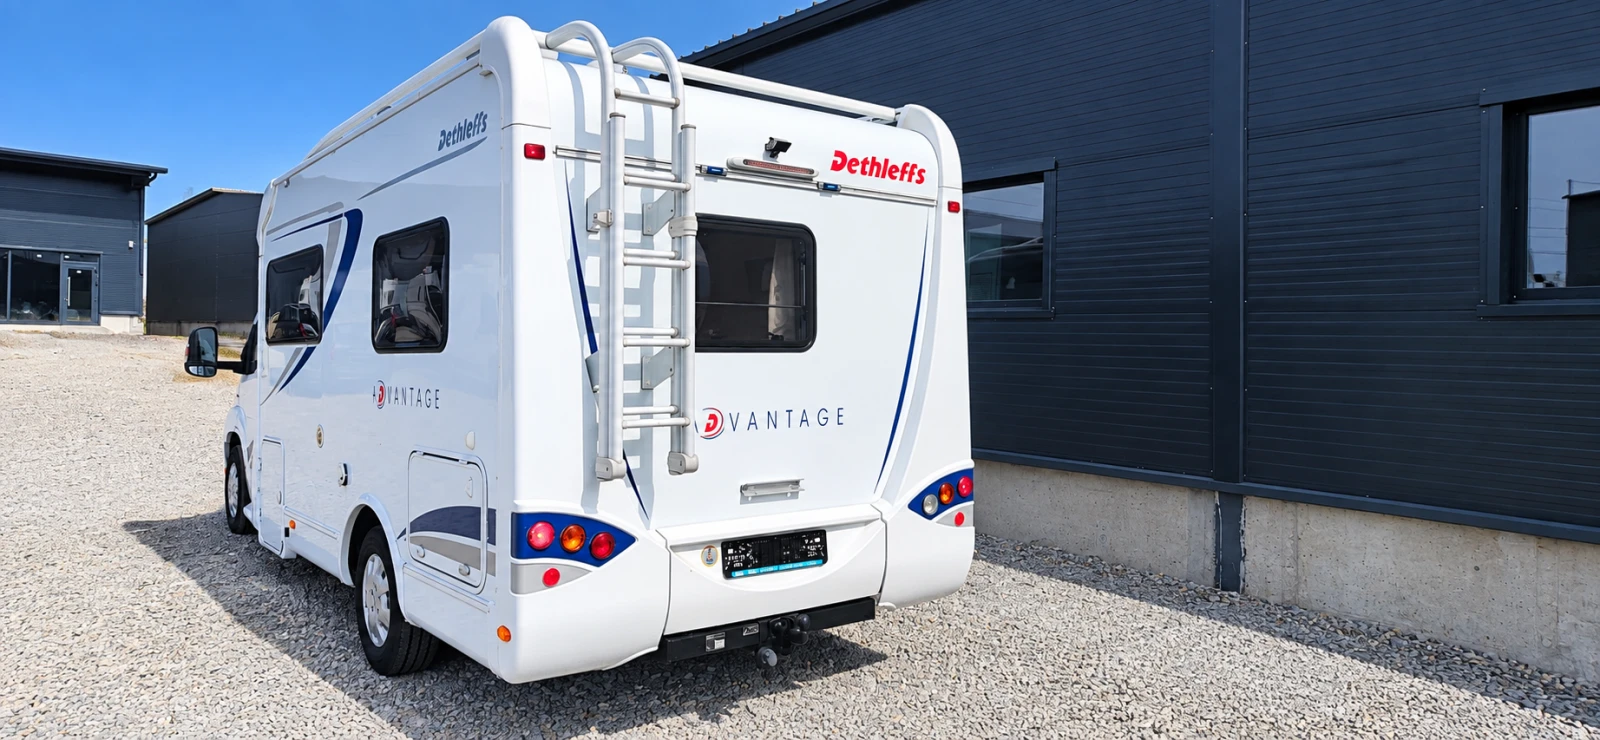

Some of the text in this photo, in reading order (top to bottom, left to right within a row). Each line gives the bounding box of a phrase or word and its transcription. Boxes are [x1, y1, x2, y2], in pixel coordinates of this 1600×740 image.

[438, 111, 488, 151] Dethleffs
[830, 150, 926, 184] Dethleffs
[372, 380, 440, 409] ADVANTAGE
